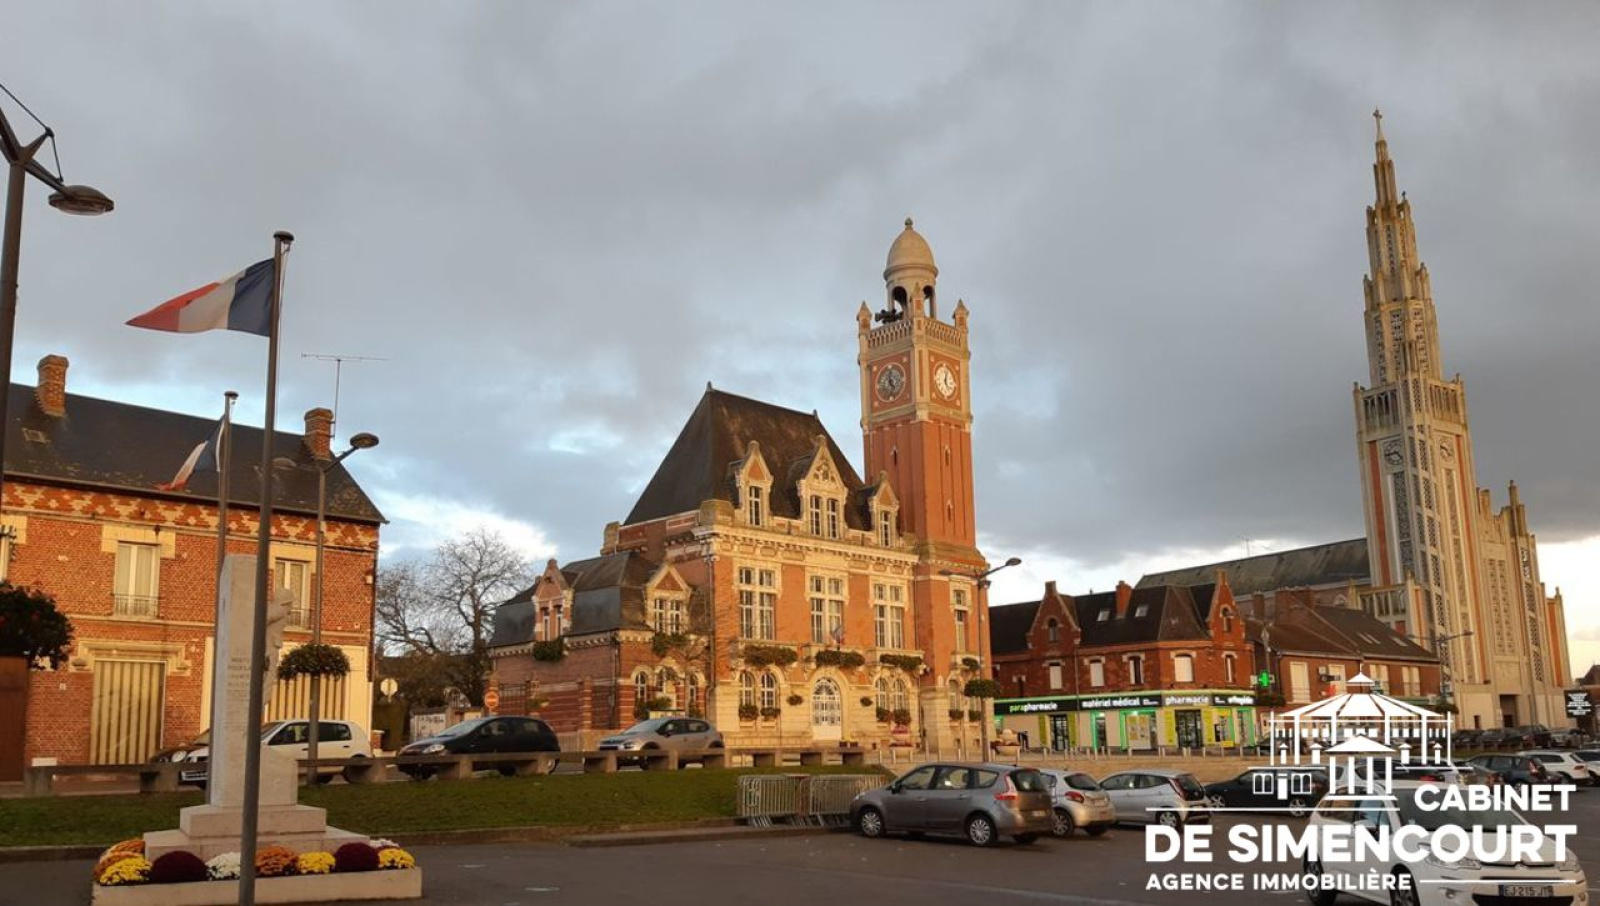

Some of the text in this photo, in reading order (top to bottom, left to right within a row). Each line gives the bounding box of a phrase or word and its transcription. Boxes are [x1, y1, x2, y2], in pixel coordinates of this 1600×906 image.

[1082, 698, 1111, 708] matériel
[1112, 696, 1140, 707] médical
[1165, 695, 1209, 706] pharmacie
[1009, 702, 1058, 713] parapharmacie
